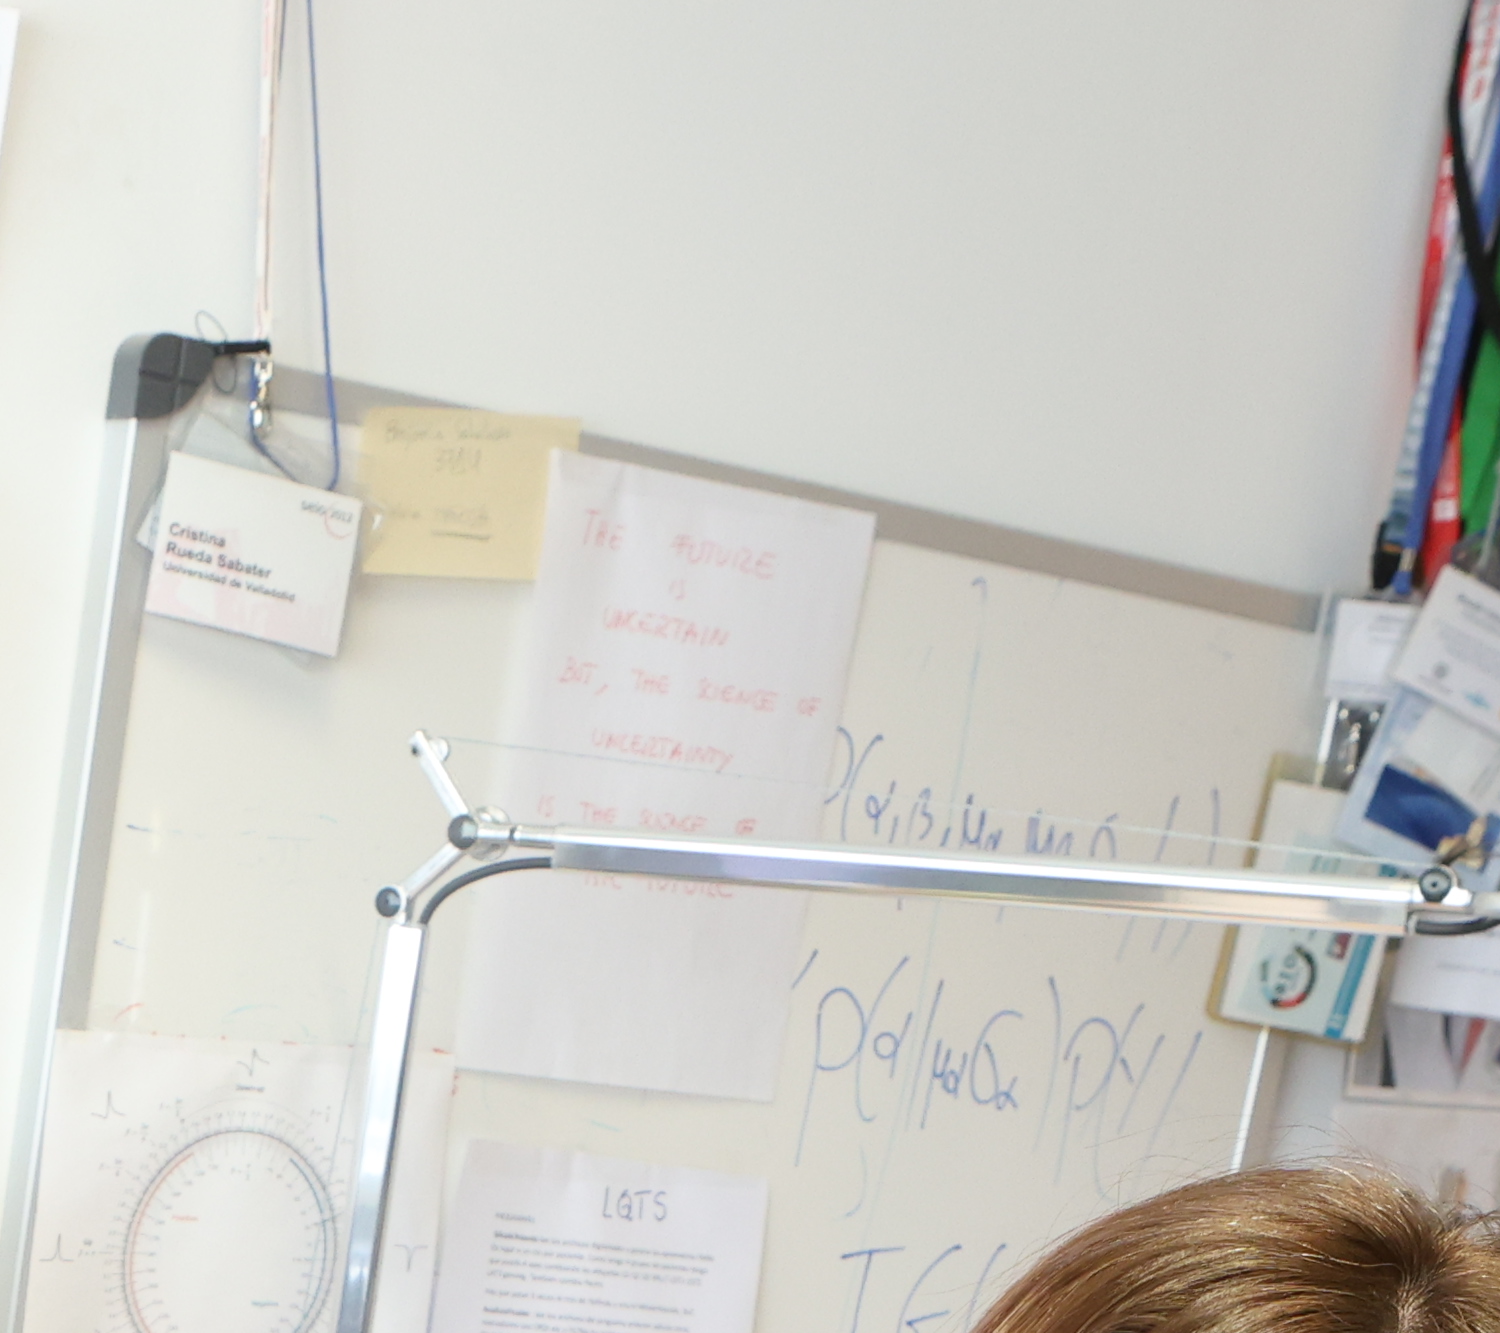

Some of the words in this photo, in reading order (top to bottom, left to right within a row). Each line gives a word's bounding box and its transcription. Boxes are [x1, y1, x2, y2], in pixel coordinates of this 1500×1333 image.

[169, 522, 226, 548] Cristina
[163, 560, 227, 586] Universidad
[230, 578, 241, 589] de
[166, 541, 213, 565] Rueda
[217, 553, 272, 579] Sabater
[604, 605, 729, 647] UNCERTAIN
[602, 1186, 668, 1222] LQTS
